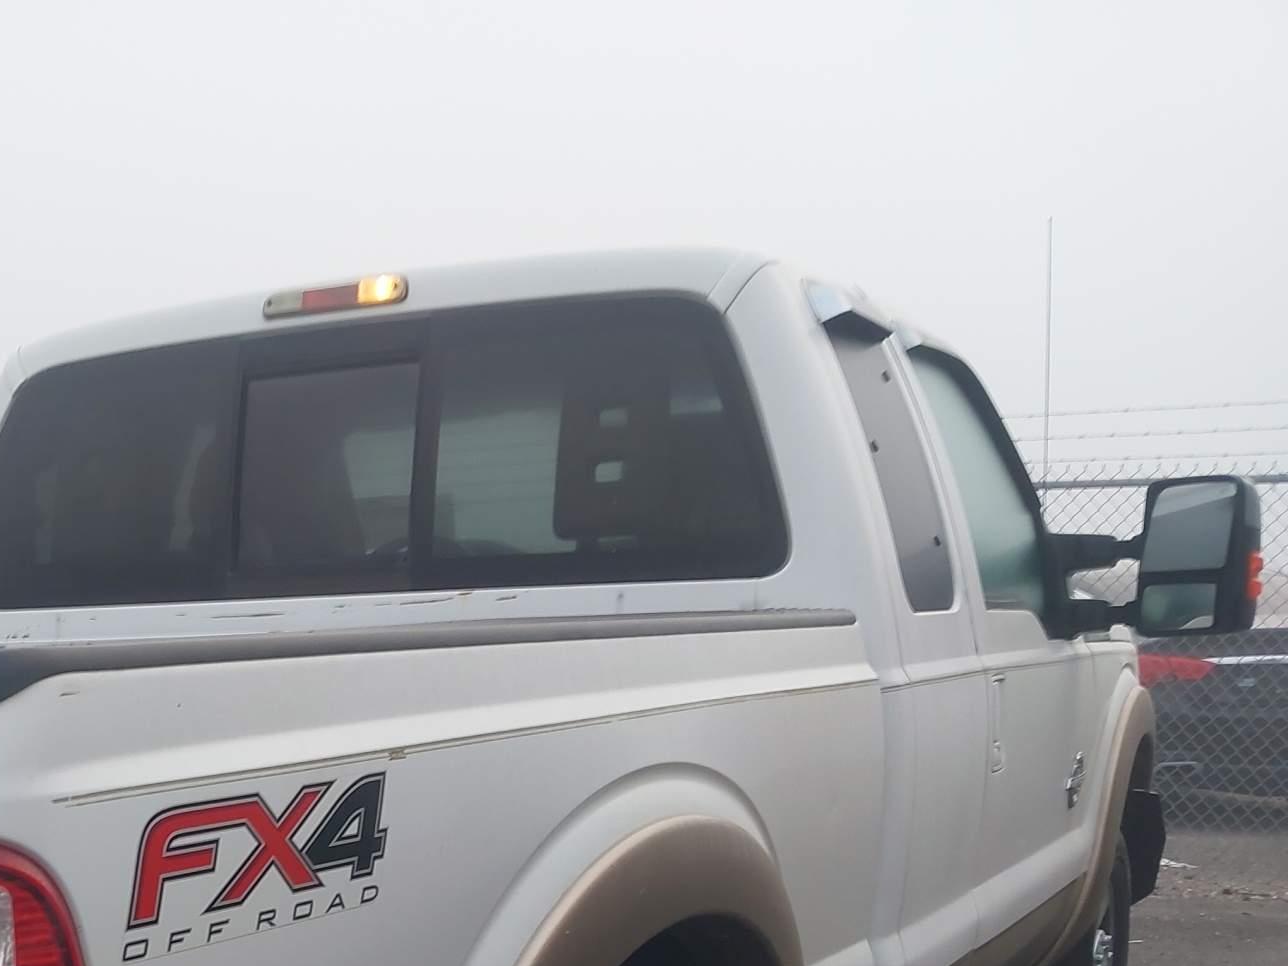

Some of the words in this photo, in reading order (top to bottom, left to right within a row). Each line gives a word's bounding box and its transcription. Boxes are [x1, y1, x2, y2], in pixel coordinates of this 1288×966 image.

[126, 771, 388, 931] FX4
[122, 918, 230, 962] OFF
[256, 884, 380, 930] ROAD
